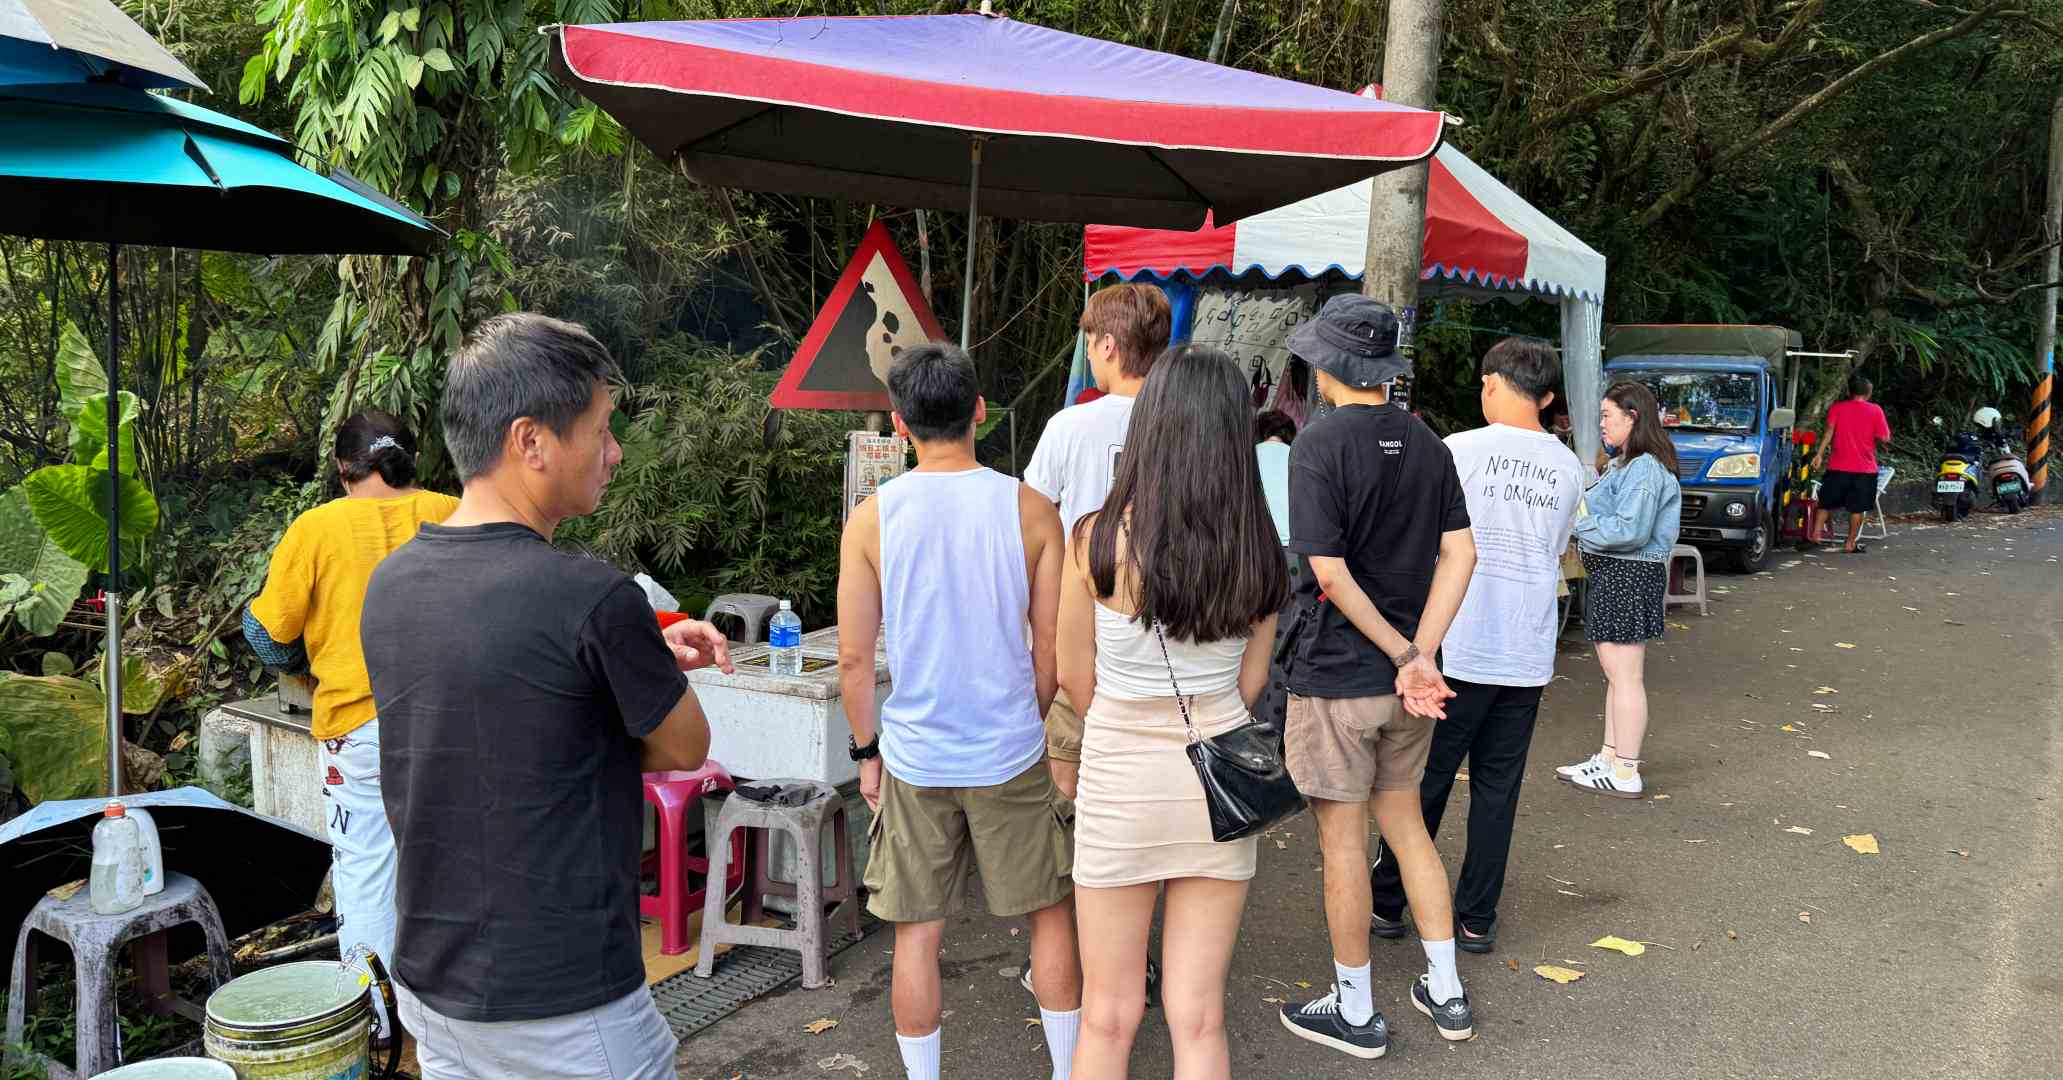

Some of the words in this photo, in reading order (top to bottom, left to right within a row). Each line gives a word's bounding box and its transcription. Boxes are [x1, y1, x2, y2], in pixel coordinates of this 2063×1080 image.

[1485, 456, 1557, 488] NOTHING
[1483, 485, 1495, 498] IS
[1504, 484, 1559, 510] ORIGINAL
[331, 804, 350, 835] N
